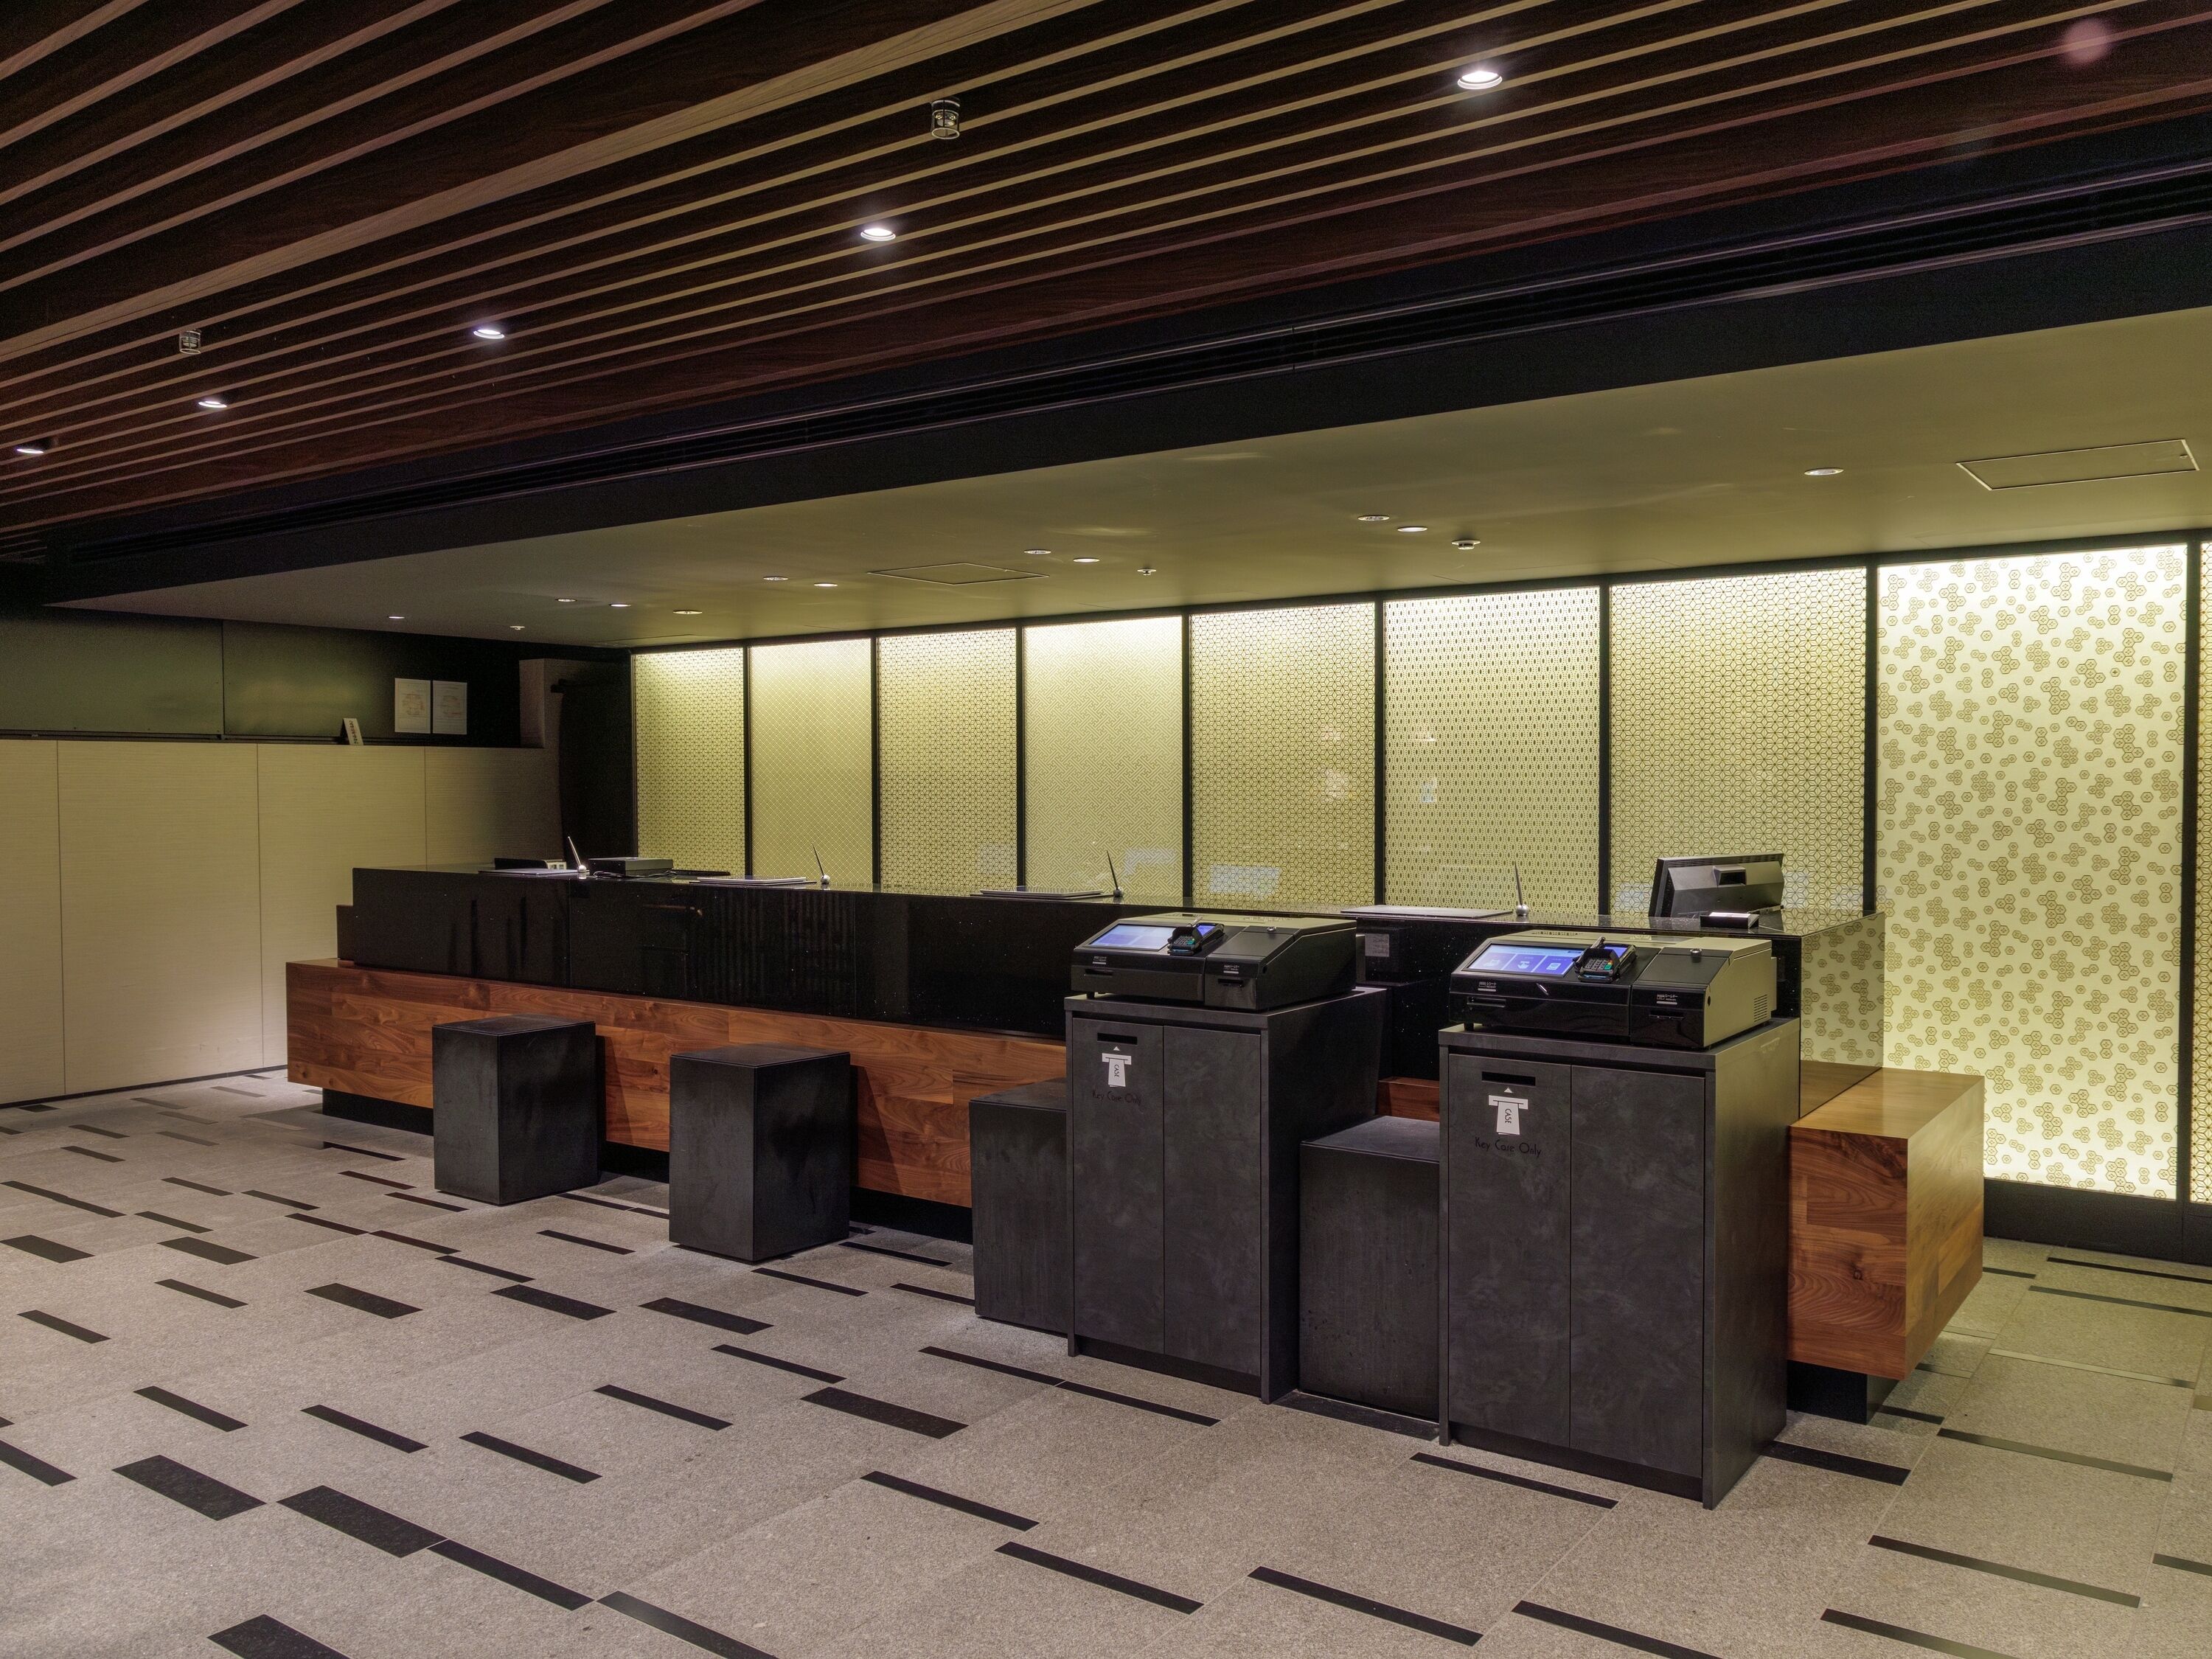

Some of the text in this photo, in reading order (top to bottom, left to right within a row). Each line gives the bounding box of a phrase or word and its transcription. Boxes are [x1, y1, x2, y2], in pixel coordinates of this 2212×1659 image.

[1092, 1089, 1105, 1101] Key
[1125, 1093, 1142, 1106] Only
[1504, 1108, 1512, 1124] CASE
[1475, 1136, 1490, 1152] Key
[1519, 1142, 1542, 1158] Only
